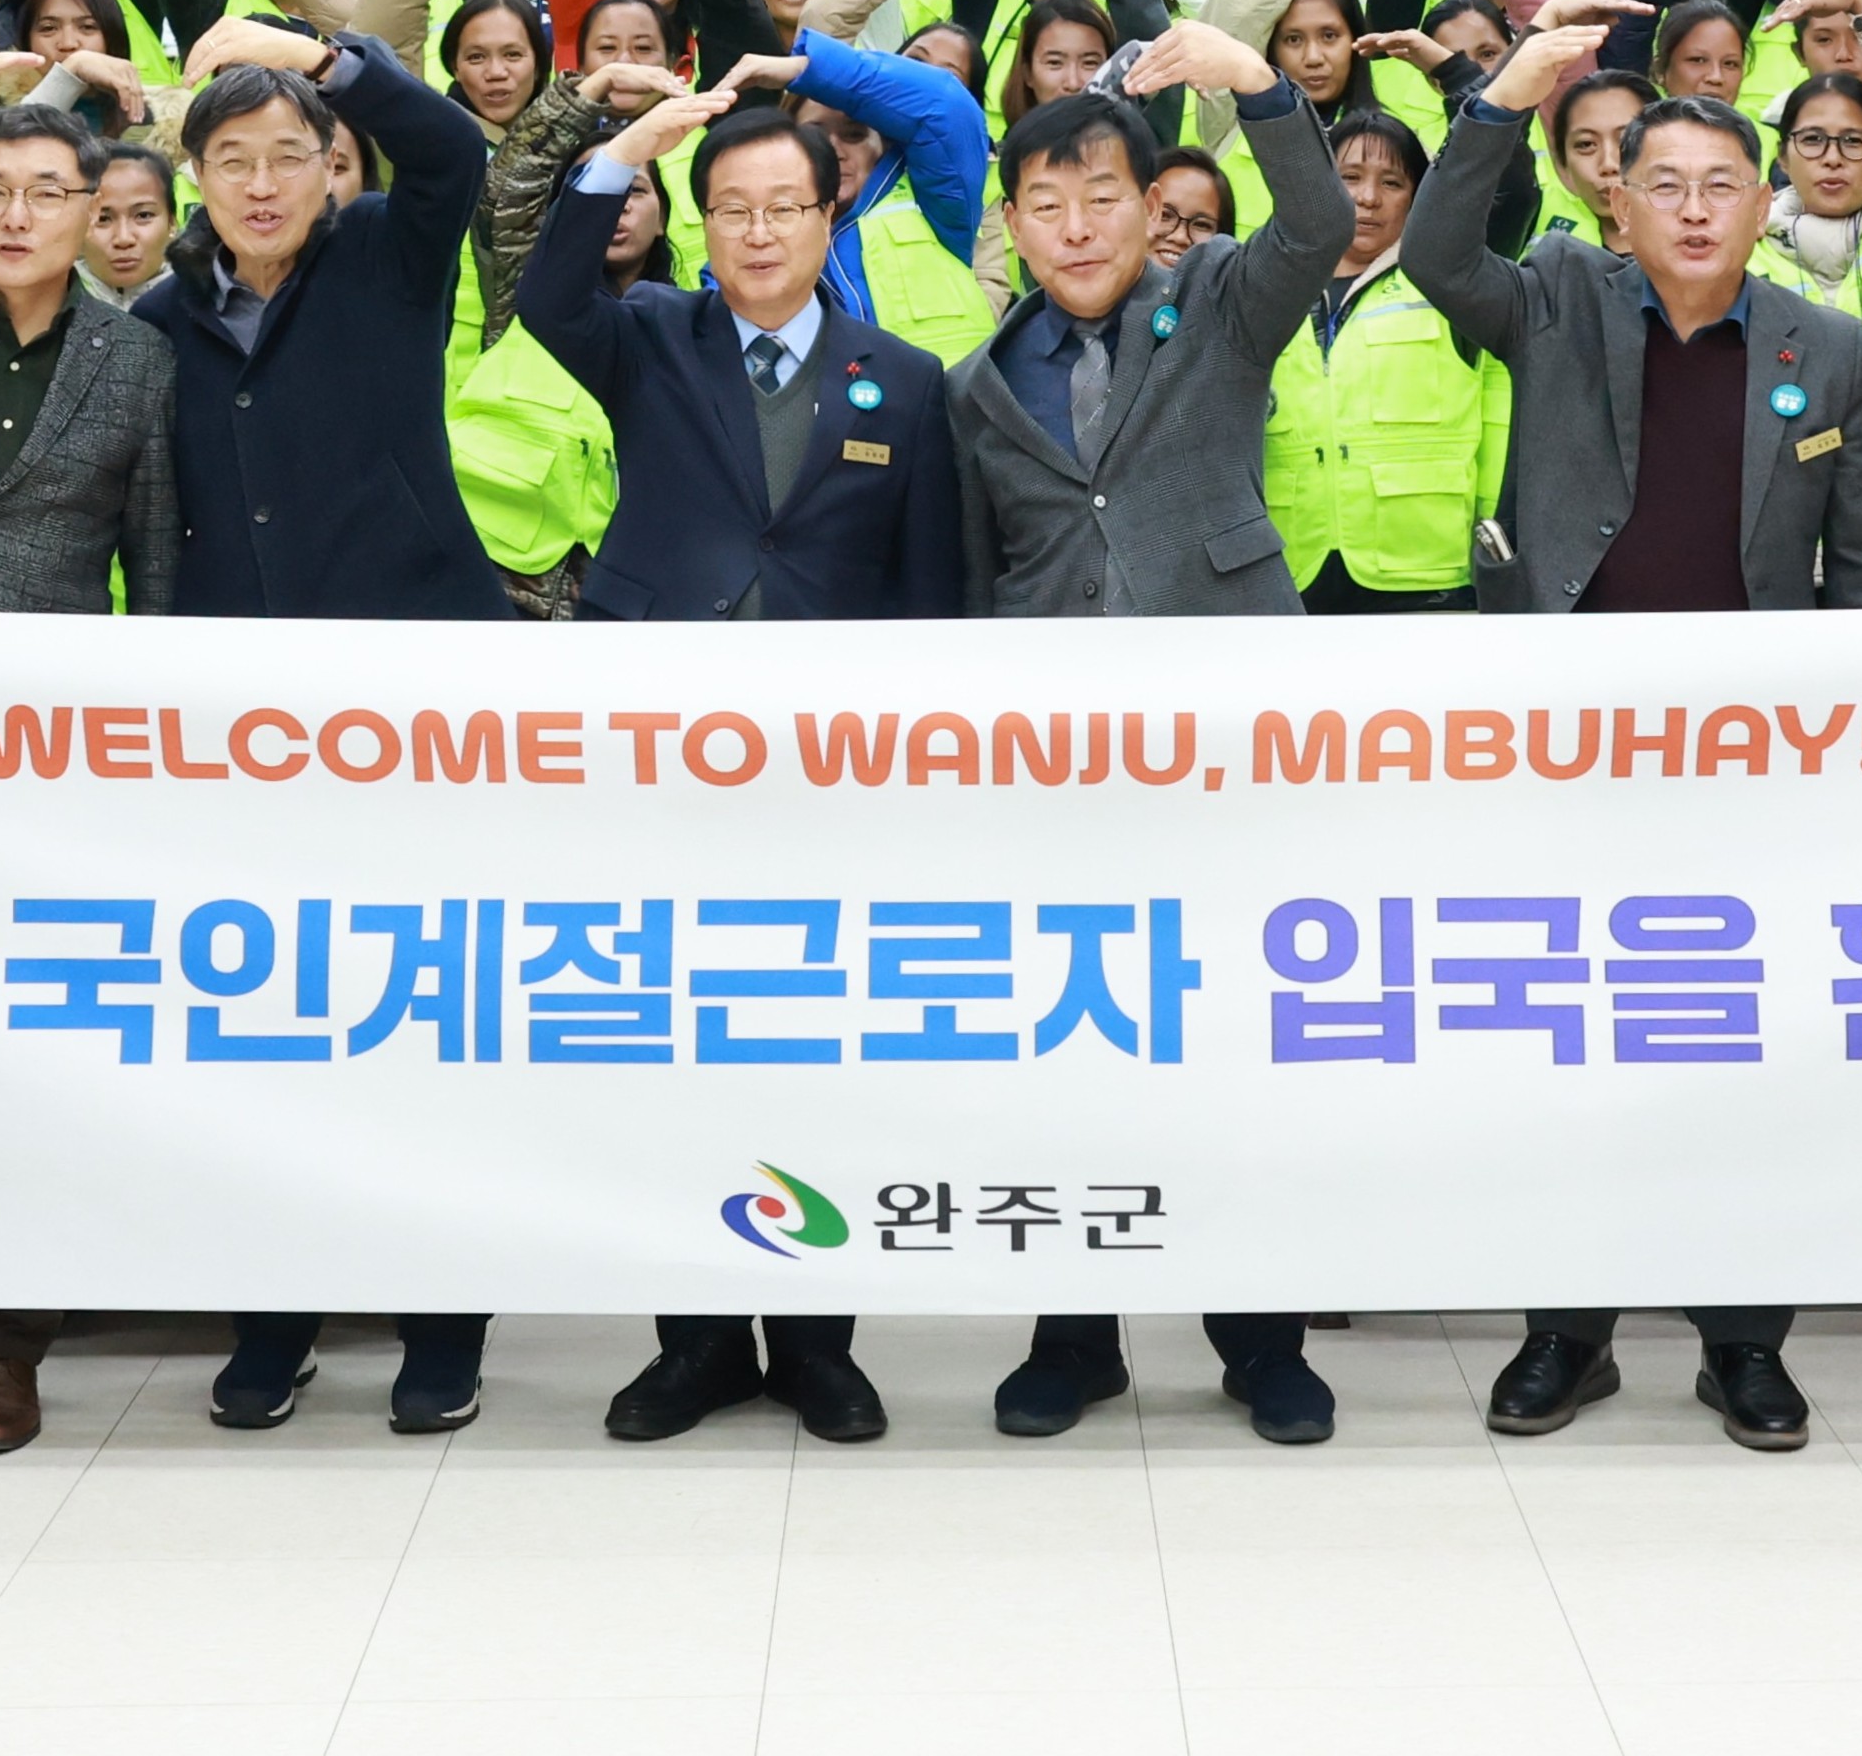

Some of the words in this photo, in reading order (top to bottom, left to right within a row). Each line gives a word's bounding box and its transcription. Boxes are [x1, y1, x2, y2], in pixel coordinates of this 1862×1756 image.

[609, 711, 769, 788] TO
[795, 711, 1225, 793] WANJU,
[1263, 895, 1765, 1066] 입국을
[872, 1182, 1168, 1253] 완주군
